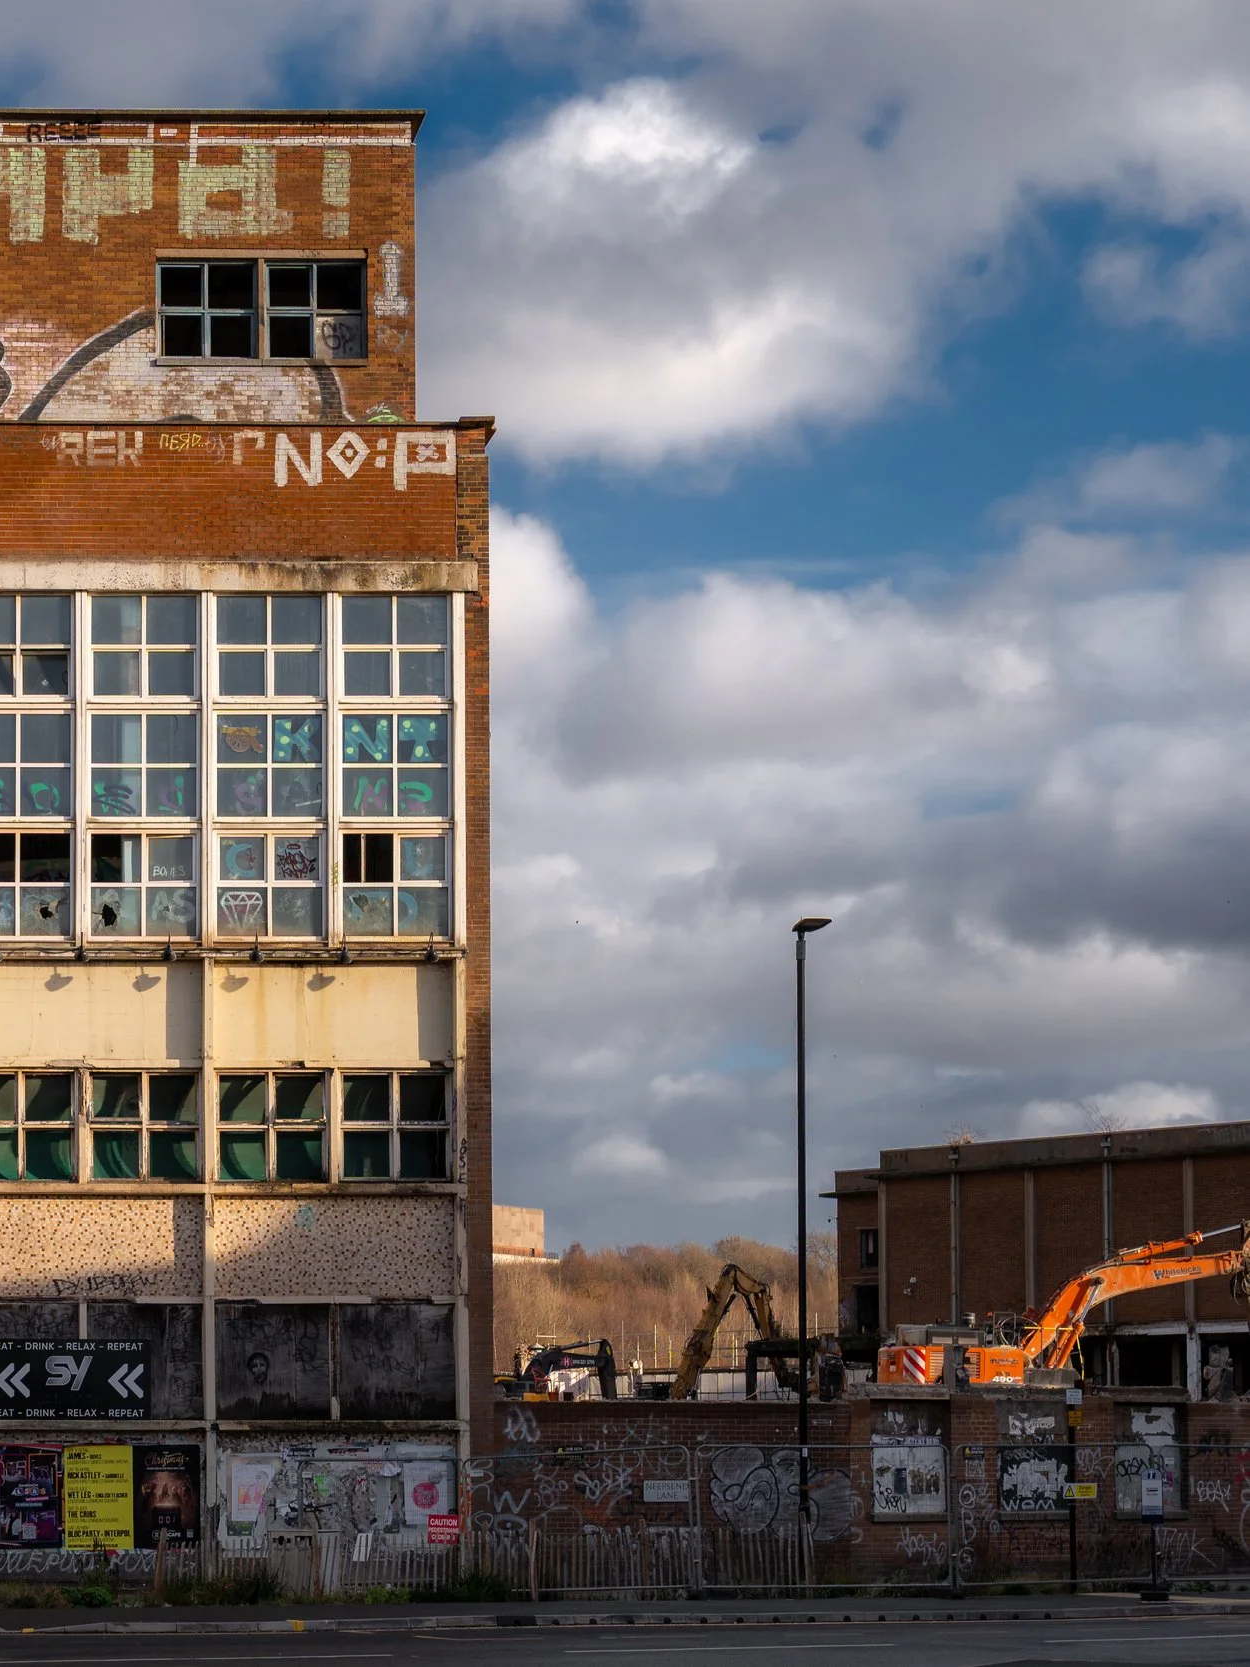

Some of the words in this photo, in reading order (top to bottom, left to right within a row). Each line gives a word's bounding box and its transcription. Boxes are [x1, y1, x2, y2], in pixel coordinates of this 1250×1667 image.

[25, 1342, 55, 1350] DRINK
[26, 1409, 55, 1417] DRINK
[67, 1409, 96, 1417] RELAX
[108, 1409, 144, 1417] REPEAT
[430, 1518, 457, 1526] CAUTION
